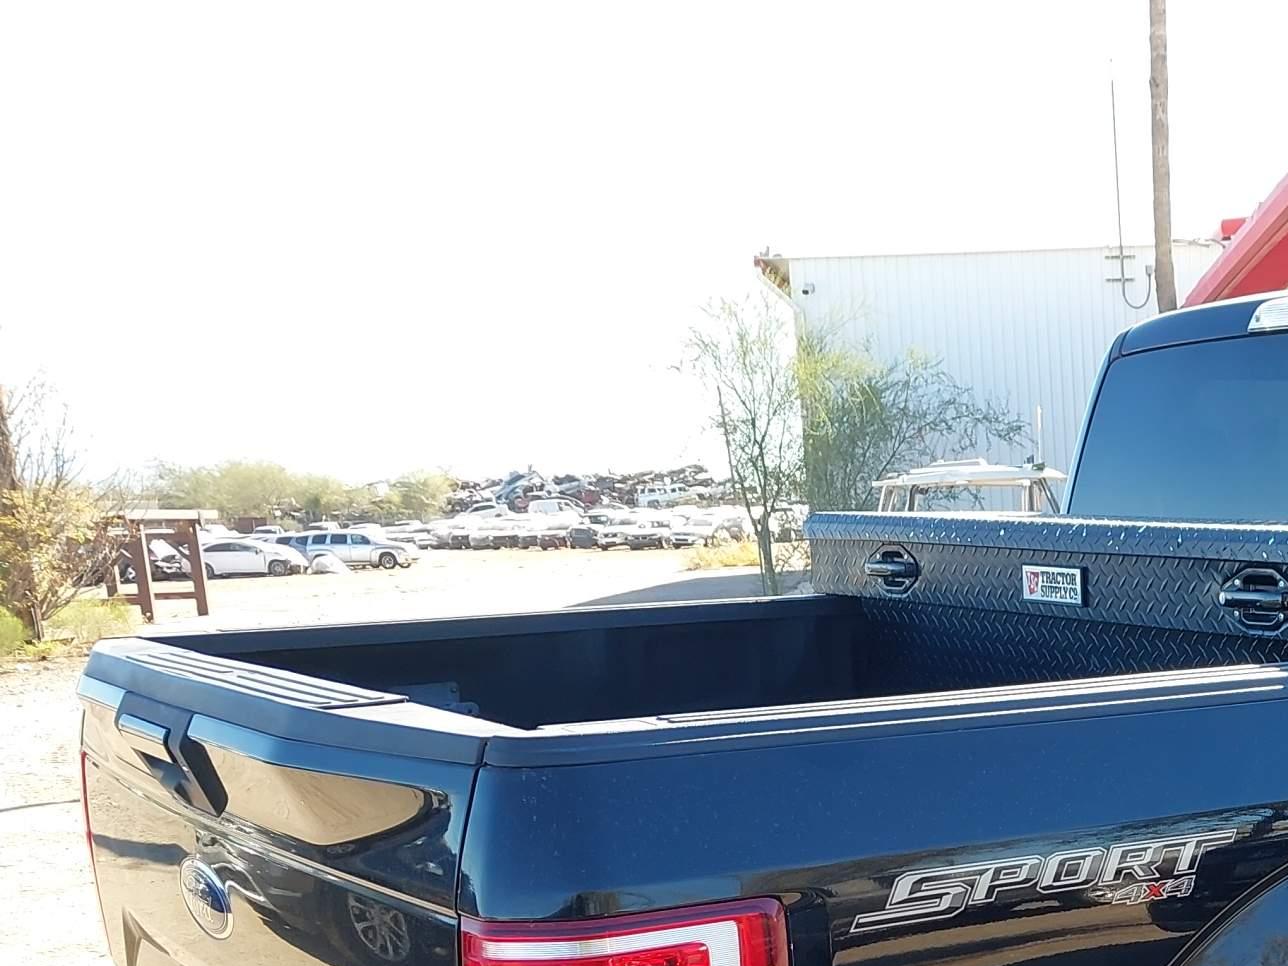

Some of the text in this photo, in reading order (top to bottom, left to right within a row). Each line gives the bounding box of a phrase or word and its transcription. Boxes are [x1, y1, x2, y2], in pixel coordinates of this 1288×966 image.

[1040, 571, 1077, 586] TRACTOR
[1040, 584, 1068, 600] SUPPLY
[849, 828, 1237, 933] SPORT
